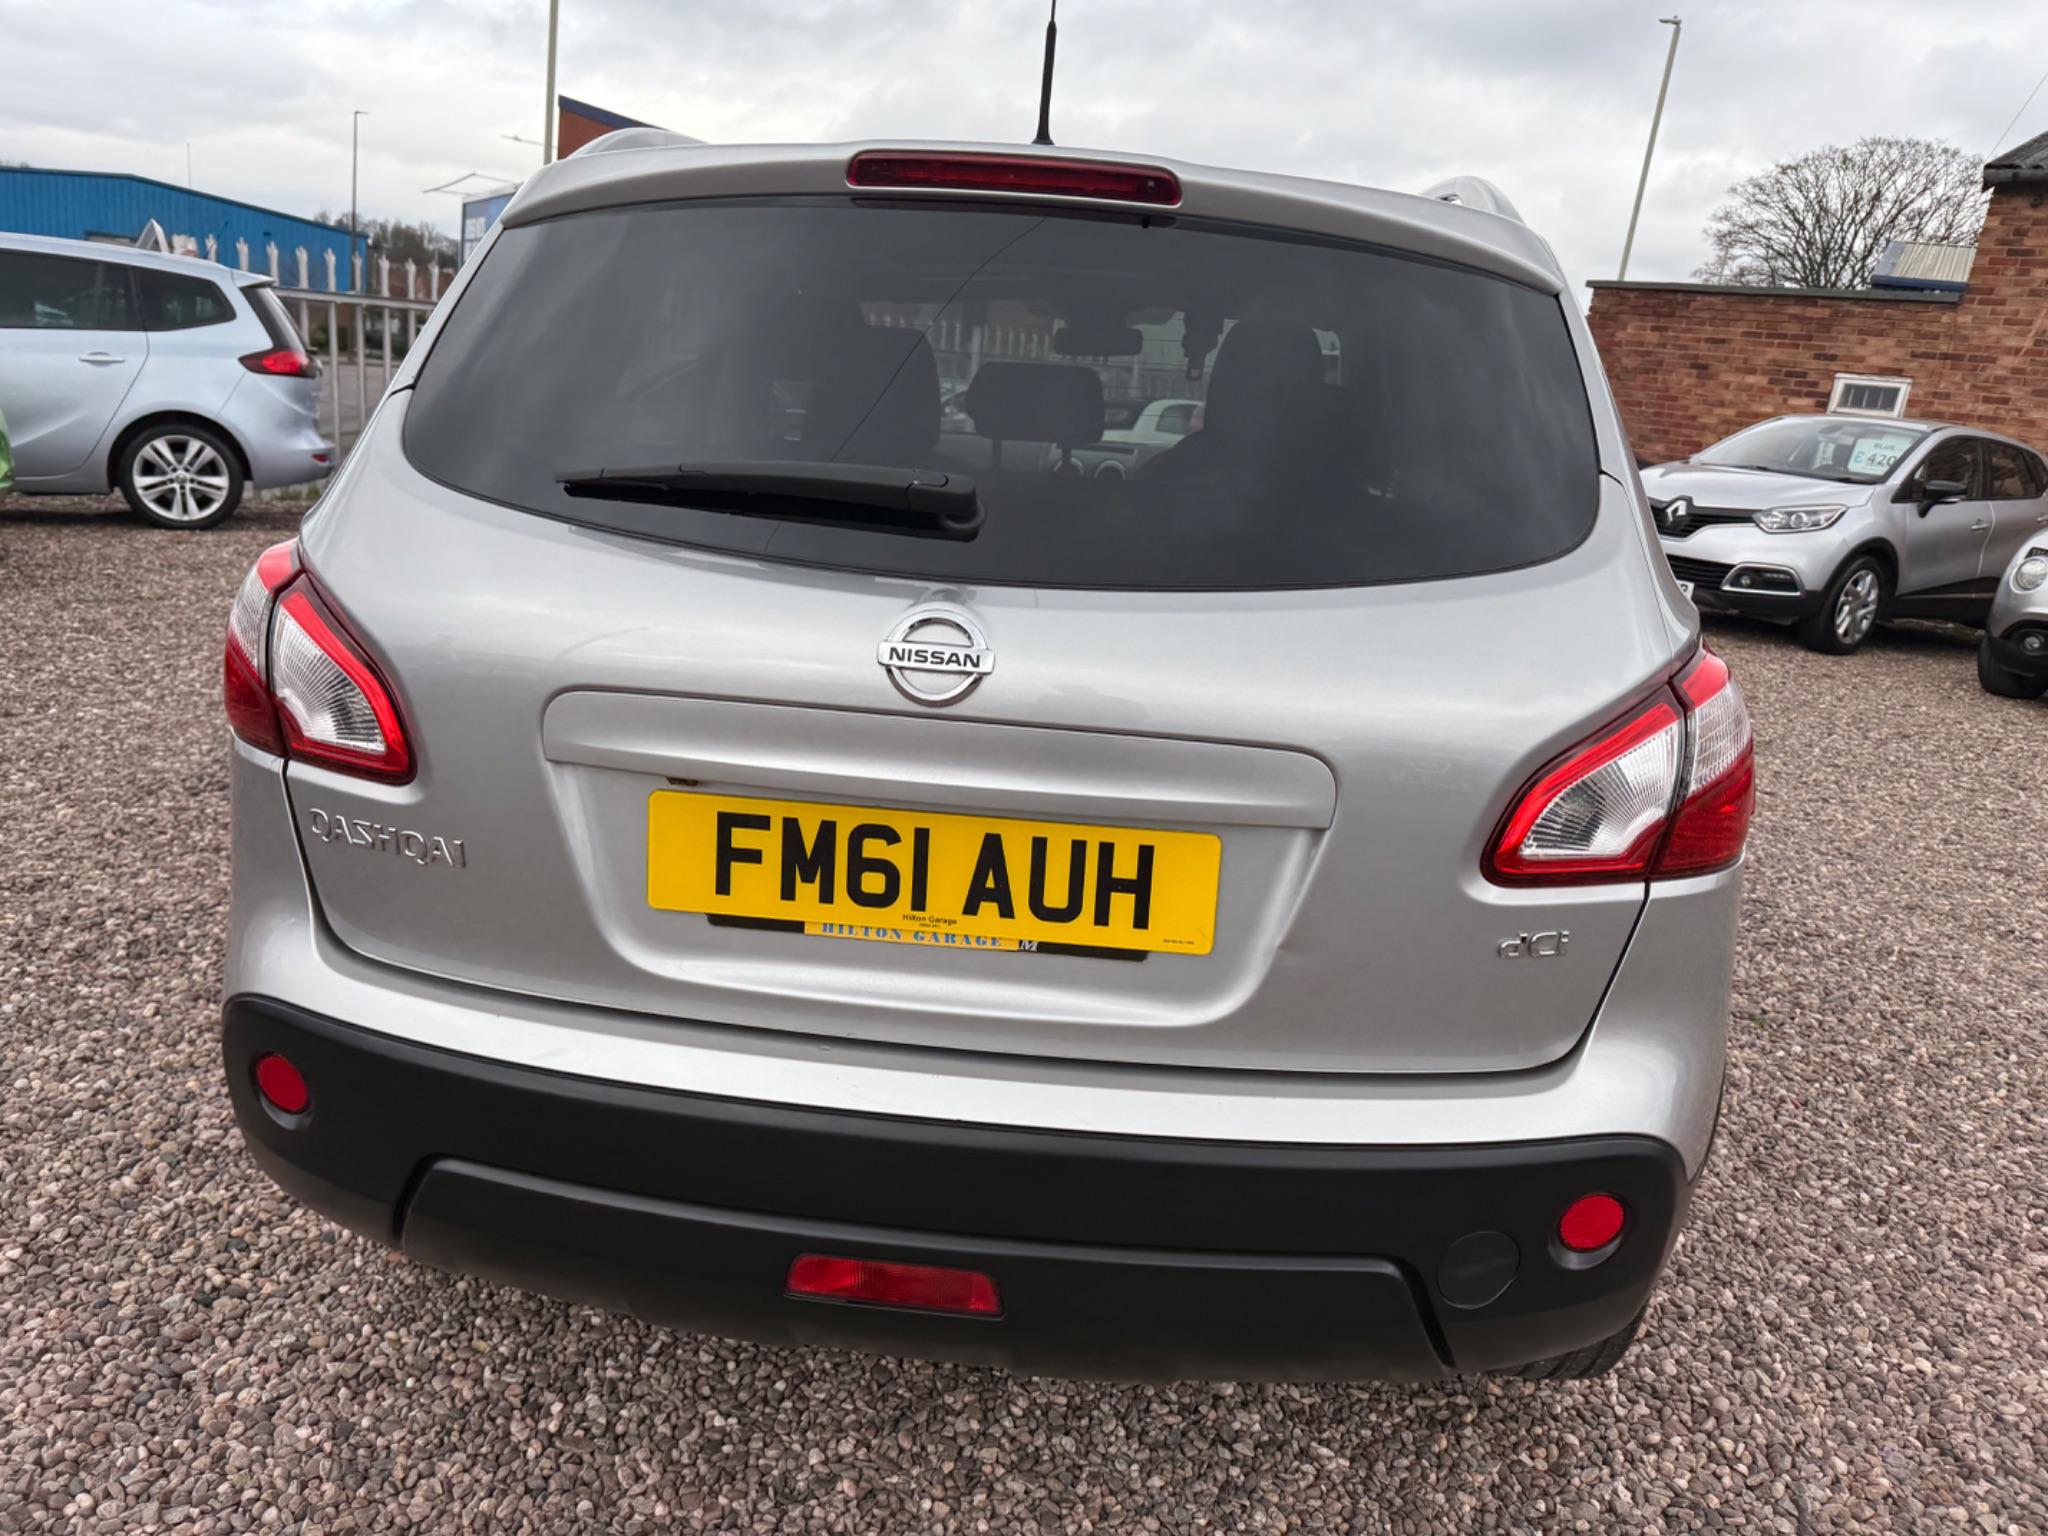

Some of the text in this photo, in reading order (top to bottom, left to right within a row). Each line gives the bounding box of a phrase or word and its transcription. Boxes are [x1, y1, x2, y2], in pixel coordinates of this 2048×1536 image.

[888, 646, 981, 669] NISSAN
[309, 807, 467, 869] QASHQAI
[714, 810, 1156, 931] FM61 AUH
[902, 913, 928, 922] Hilton
[928, 915, 958, 926] Garage
[821, 922, 1002, 948] HILTON GARAGE
